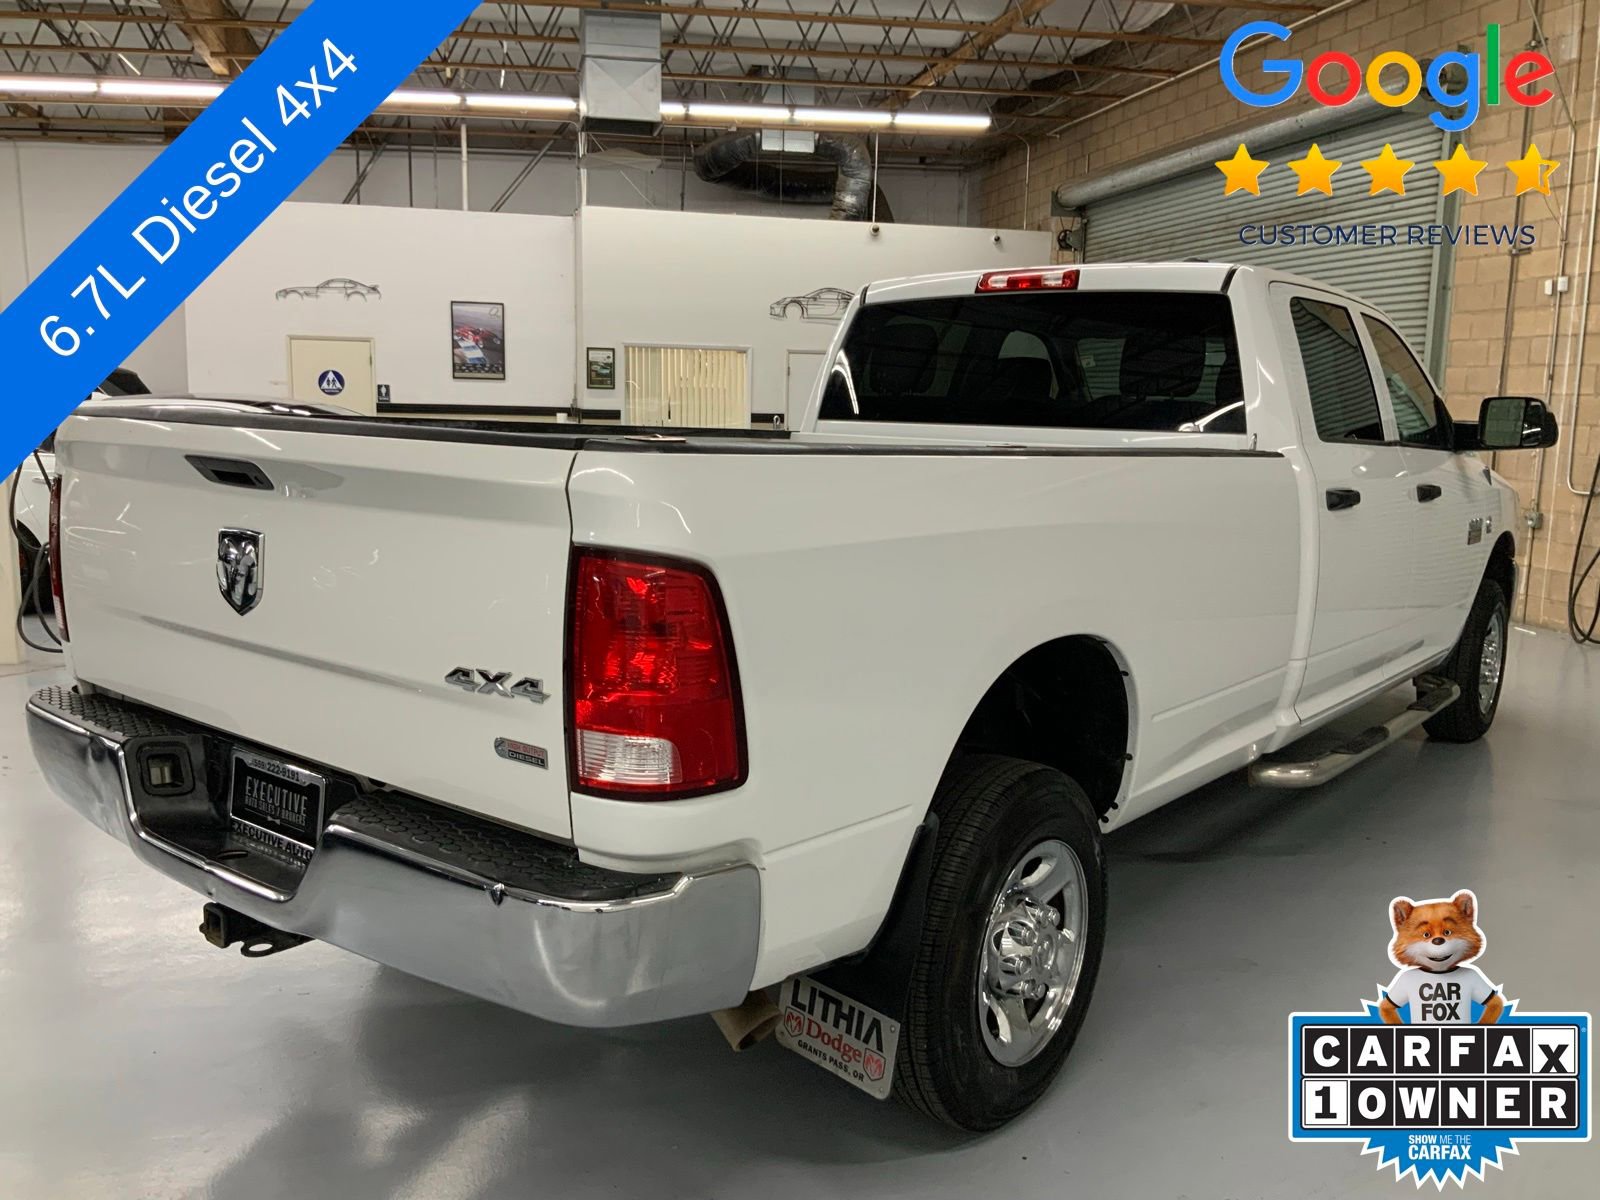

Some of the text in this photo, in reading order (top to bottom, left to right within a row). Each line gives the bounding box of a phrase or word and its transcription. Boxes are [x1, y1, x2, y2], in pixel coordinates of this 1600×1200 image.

[508, 751, 545, 766] DIESEL
[245, 776, 308, 817] EXECUTIVE
[791, 978, 884, 1054] LITHIA
[798, 1040, 828, 1061] GRANTS
[853, 1069, 865, 1083] OR
[806, 1017, 862, 1063] Dodge
